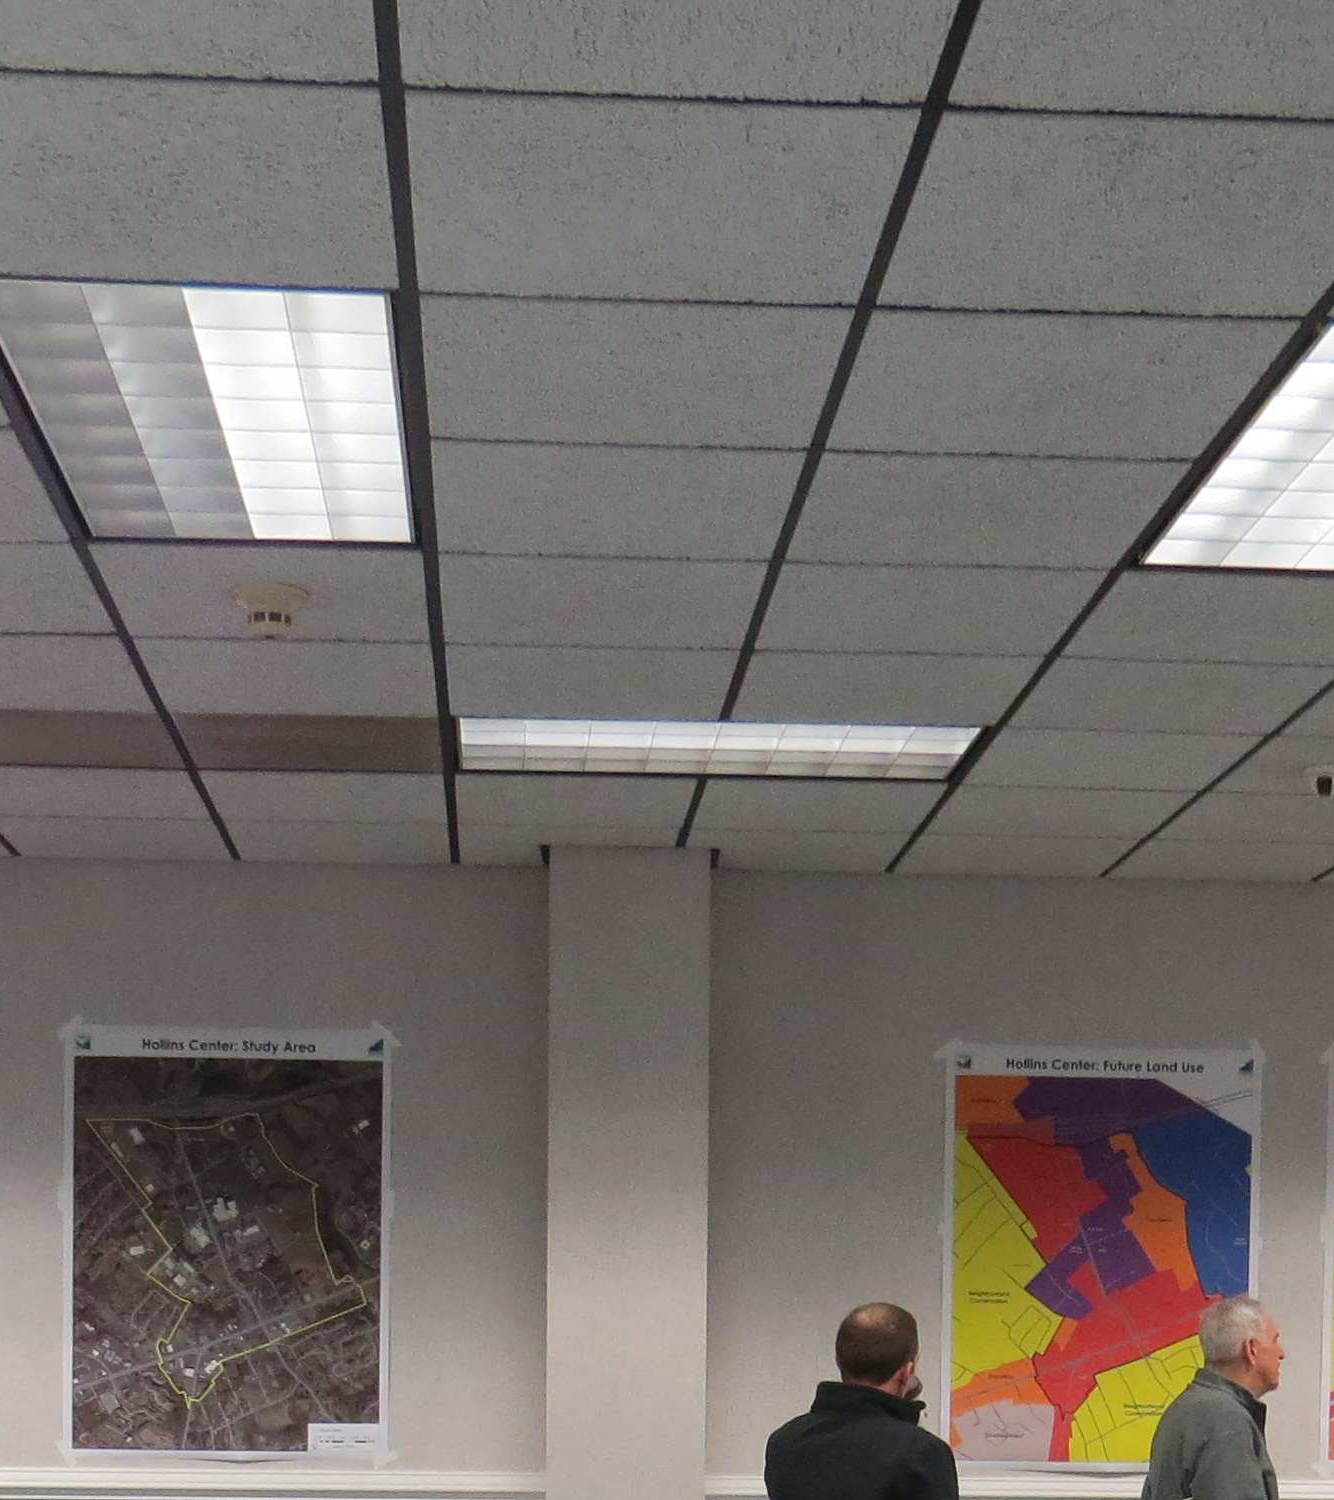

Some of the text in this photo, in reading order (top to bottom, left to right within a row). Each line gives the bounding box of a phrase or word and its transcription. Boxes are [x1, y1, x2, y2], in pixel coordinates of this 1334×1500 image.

[141, 1038, 317, 1055] Hollins Center: Study Area
[1005, 1058, 1205, 1074] Hollins Center: Future Land Use
